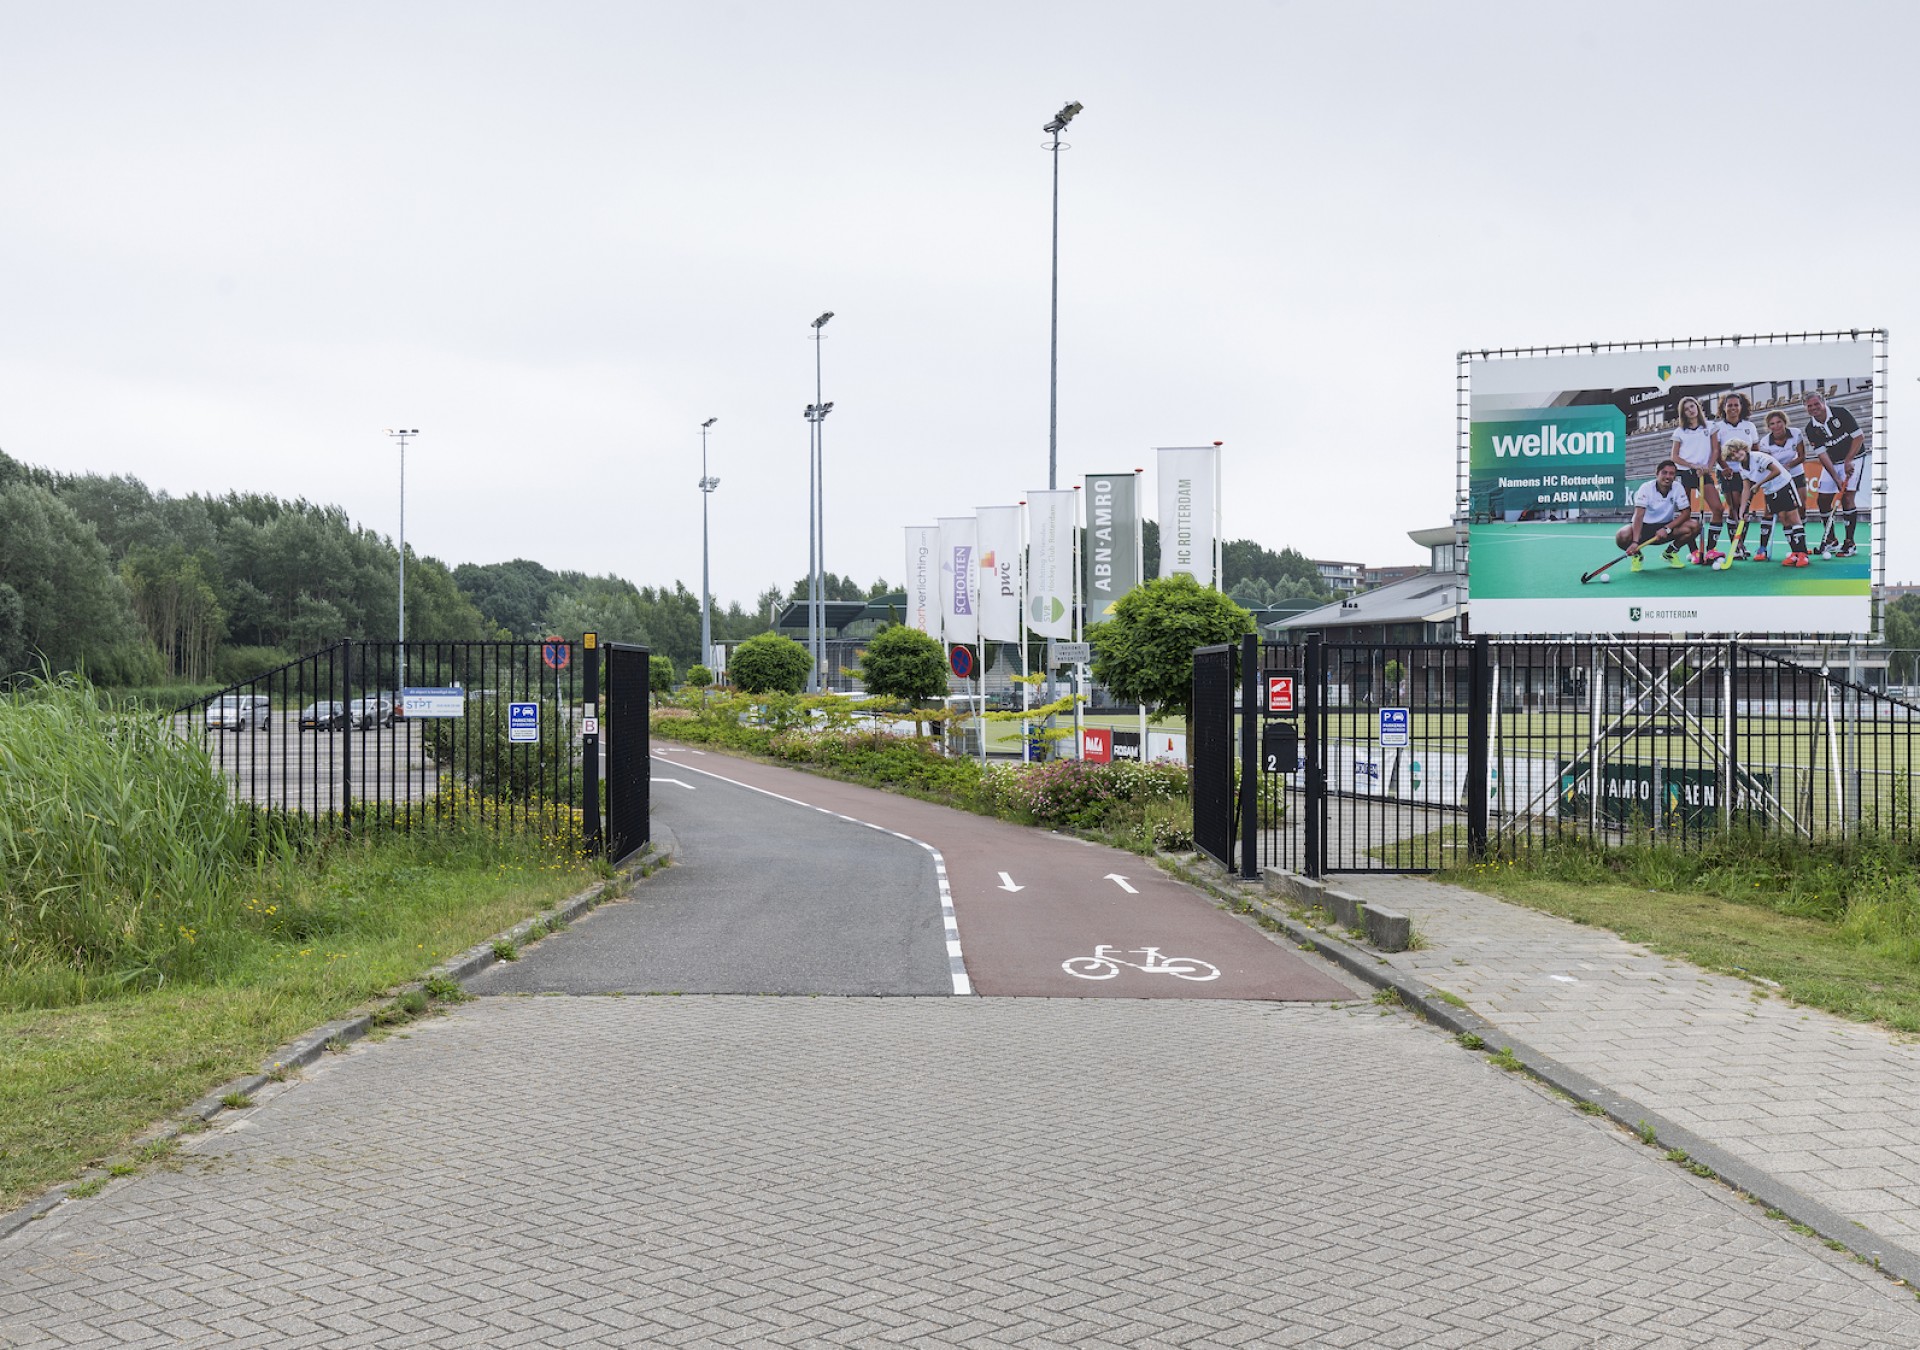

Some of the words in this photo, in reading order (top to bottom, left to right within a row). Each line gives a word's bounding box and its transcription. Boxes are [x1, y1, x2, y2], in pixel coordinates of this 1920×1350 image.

[1492, 424, 1615, 458] welkom
[1498, 477, 1540, 488] Namens
[1543, 475, 1558, 487] HC
[1561, 473, 1615, 486] Rotterdam
[1538, 494, 1551, 504] en
[1553, 491, 1578, 503] ABN
[1580, 490, 1614, 501] AMRO
[1178, 479, 1191, 546] ROTTERDAM
[1048, 504, 1056, 544] Rotterdam
[1094, 480, 1112, 592] ABN·AMRO
[1048, 545, 1056, 562] Club
[1178, 549, 1191, 565] HC
[916, 530, 929, 633] portverlichting.com
[955, 547, 966, 613] SCHOUTEN
[1001, 562, 1014, 597] pwc
[1048, 565, 1056, 592] Hockey
[1043, 604, 1051, 622] SVR
[1644, 610, 1655, 619] HC
[1656, 610, 1698, 619] ROTTERDAM
[585, 720, 595, 732] B
[1267, 754, 1277, 771] 2
